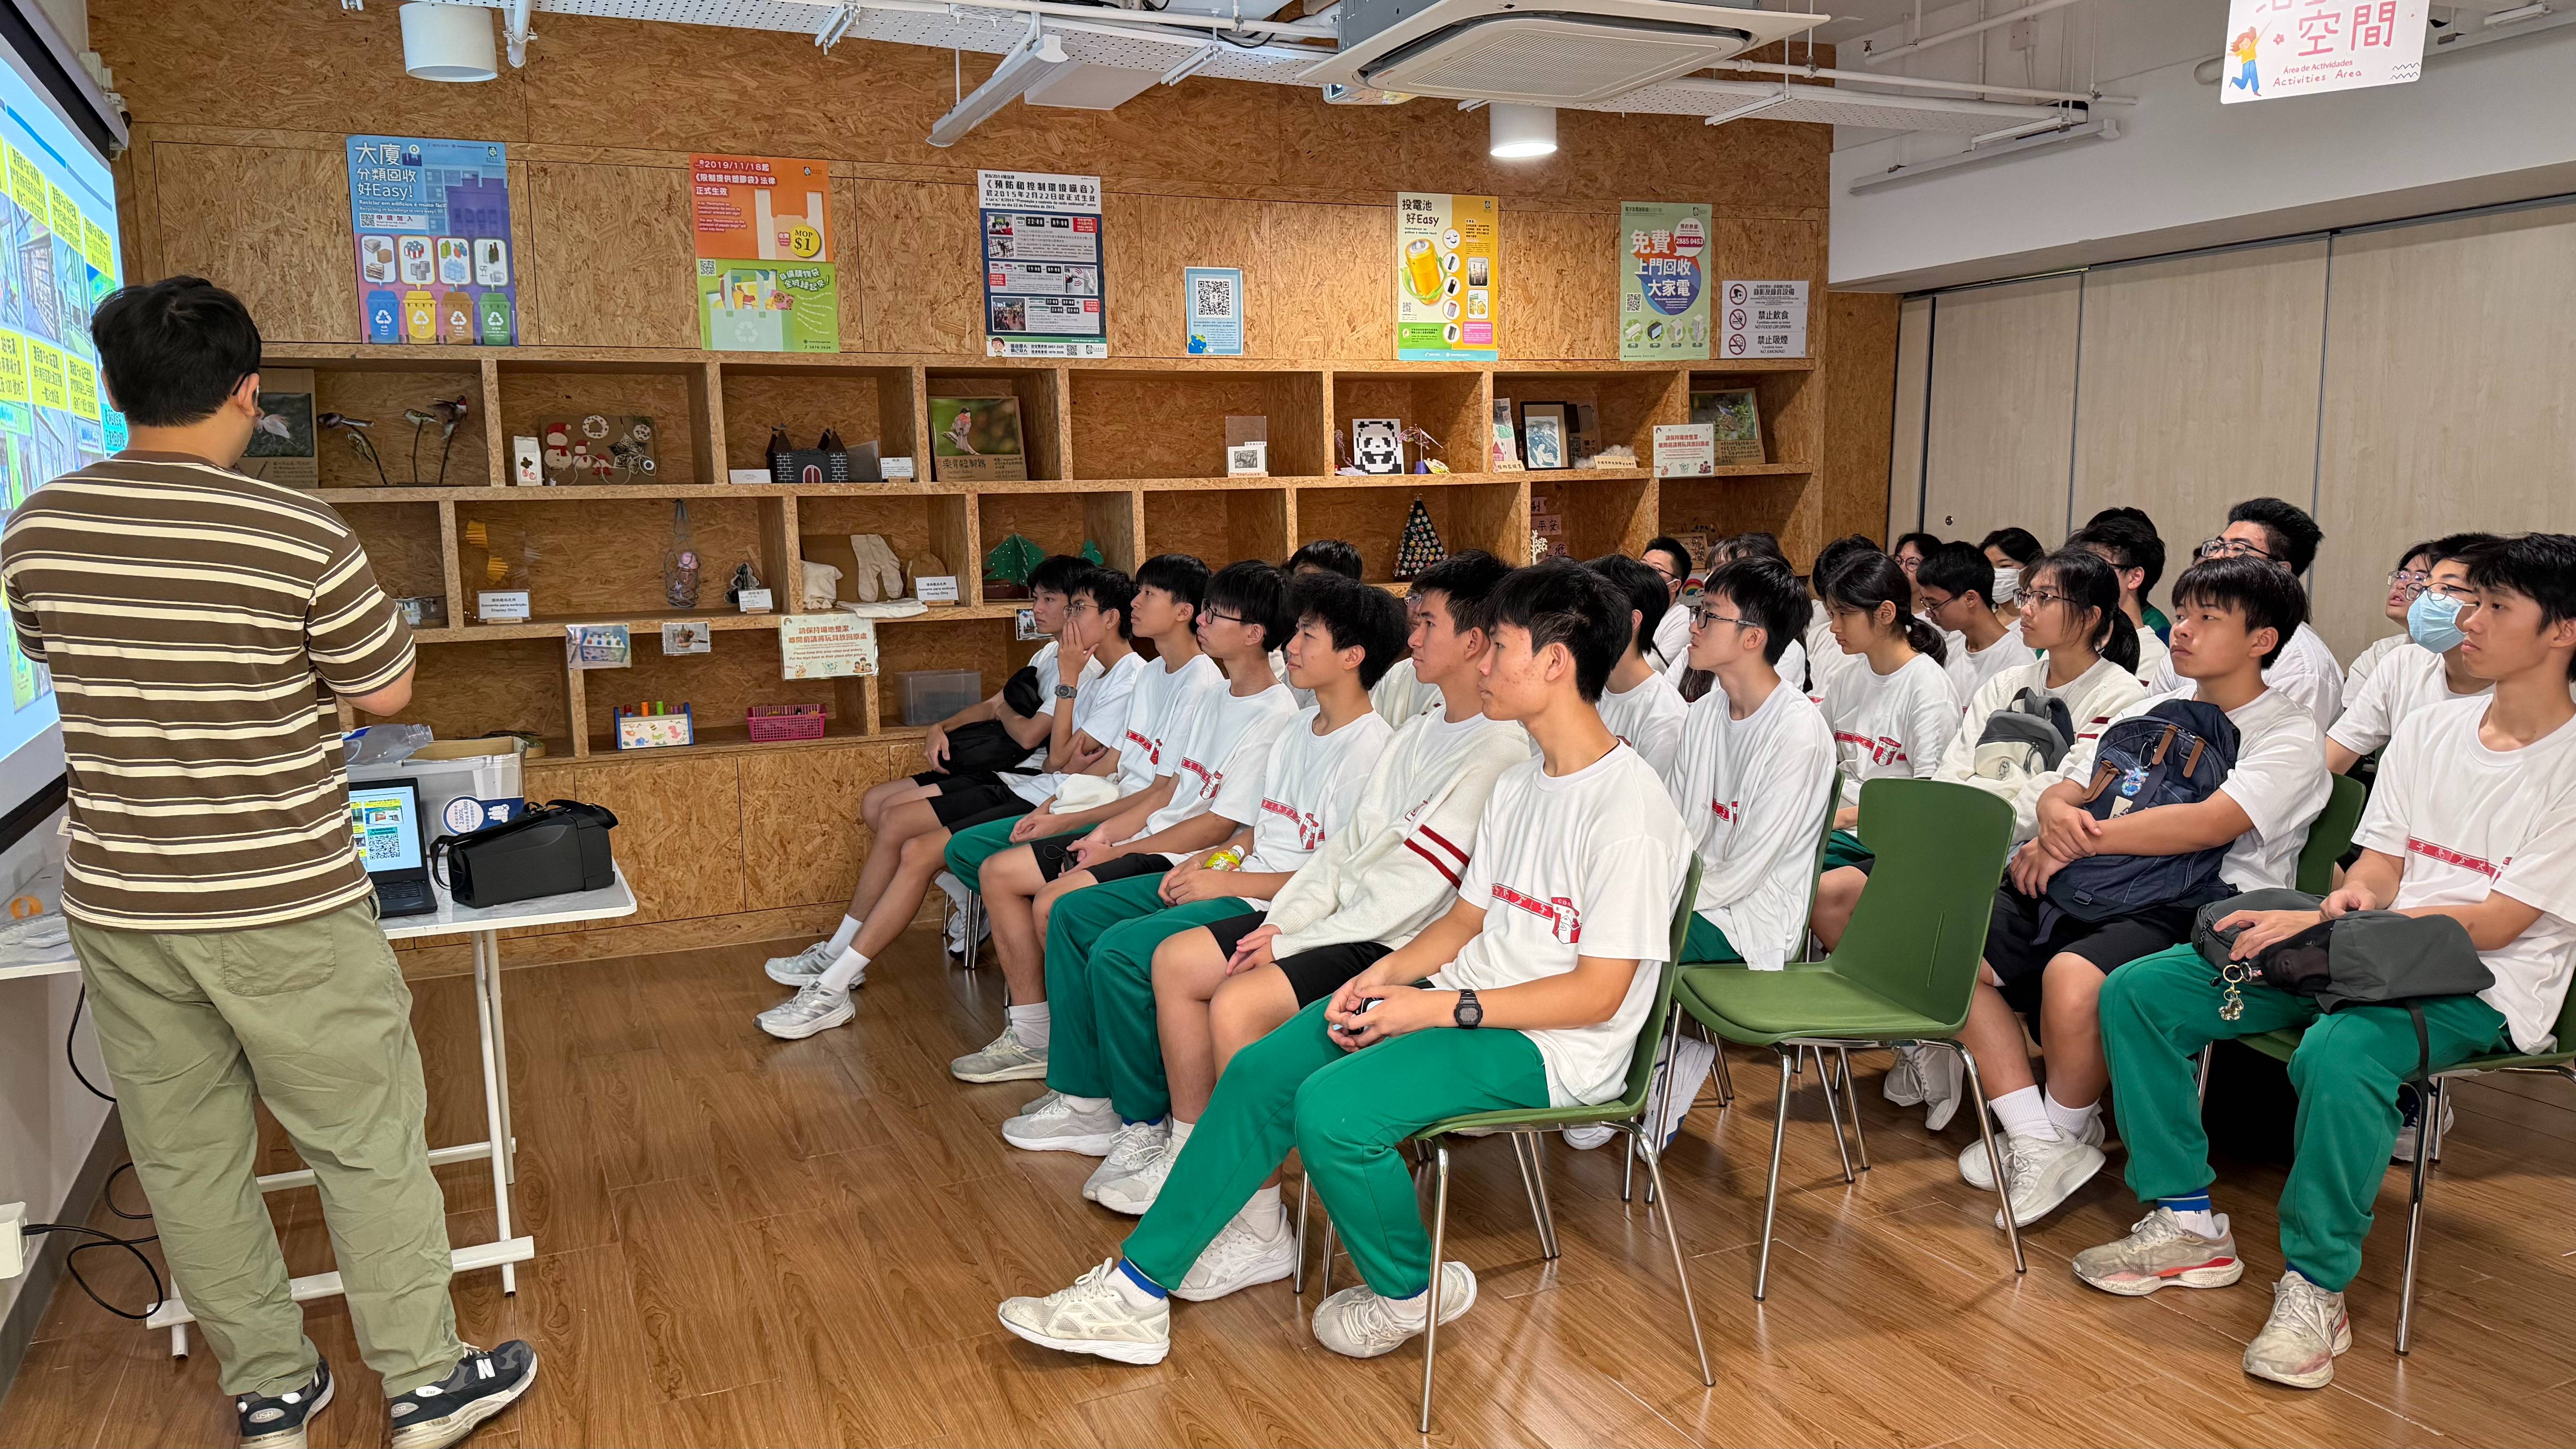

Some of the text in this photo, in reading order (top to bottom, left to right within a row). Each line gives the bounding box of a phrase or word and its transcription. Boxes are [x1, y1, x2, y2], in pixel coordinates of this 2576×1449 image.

[2298, 1, 2397, 56] 空間
[2283, 66, 2300, 74] Área
[2311, 60, 2353, 71] Actividades
[2273, 69, 2362, 87] Activities Area
[355, 143, 401, 166] 大廈
[357, 168, 416, 182] 分類回收
[695, 186, 728, 196] 正式生效
[987, 179, 1095, 194] 《預防和控制環境噪音》
[986, 190, 1095, 202] 於2015年2月22日起正式生效
[1402, 199, 1432, 211] 投電池
[1406, 213, 1439, 227] 好Easy
[795, 230, 813, 238] MOP
[795, 237, 811, 251] $1
[1630, 229, 1670, 254] 免費
[1634, 258, 1691, 276] 上門回收
[1648, 279, 1690, 297] 大家電
[1758, 310, 1789, 320] 禁止飲食
[1757, 335, 1788, 345] 禁止吸煙
[1538, 519, 1557, 531] 平安
[476, 1358, 495, 1379] N
